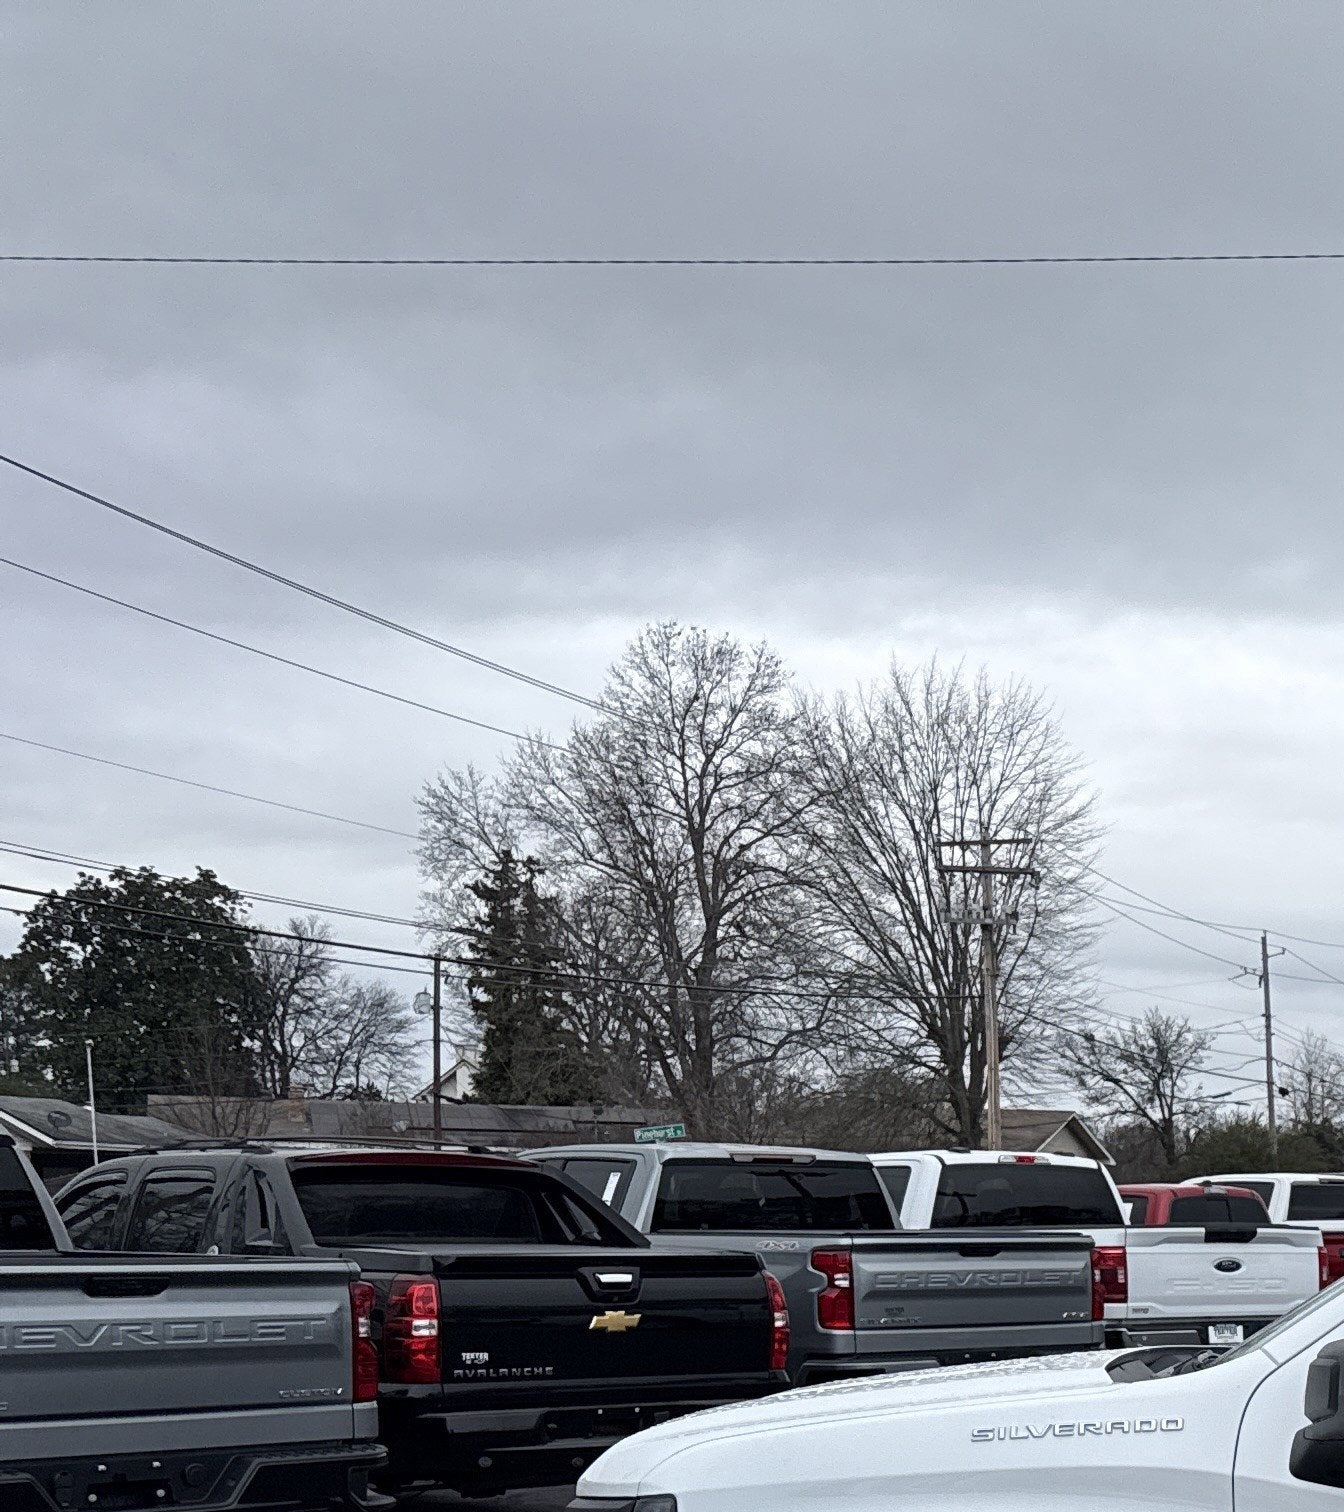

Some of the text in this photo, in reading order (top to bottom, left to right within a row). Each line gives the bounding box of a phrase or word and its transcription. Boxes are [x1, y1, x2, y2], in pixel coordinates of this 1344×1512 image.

[874, 1270, 1082, 1288] CHEVROLET
[453, 1366, 554, 1378] AVALANCHE
[971, 1416, 1185, 1442] SILVERADO
